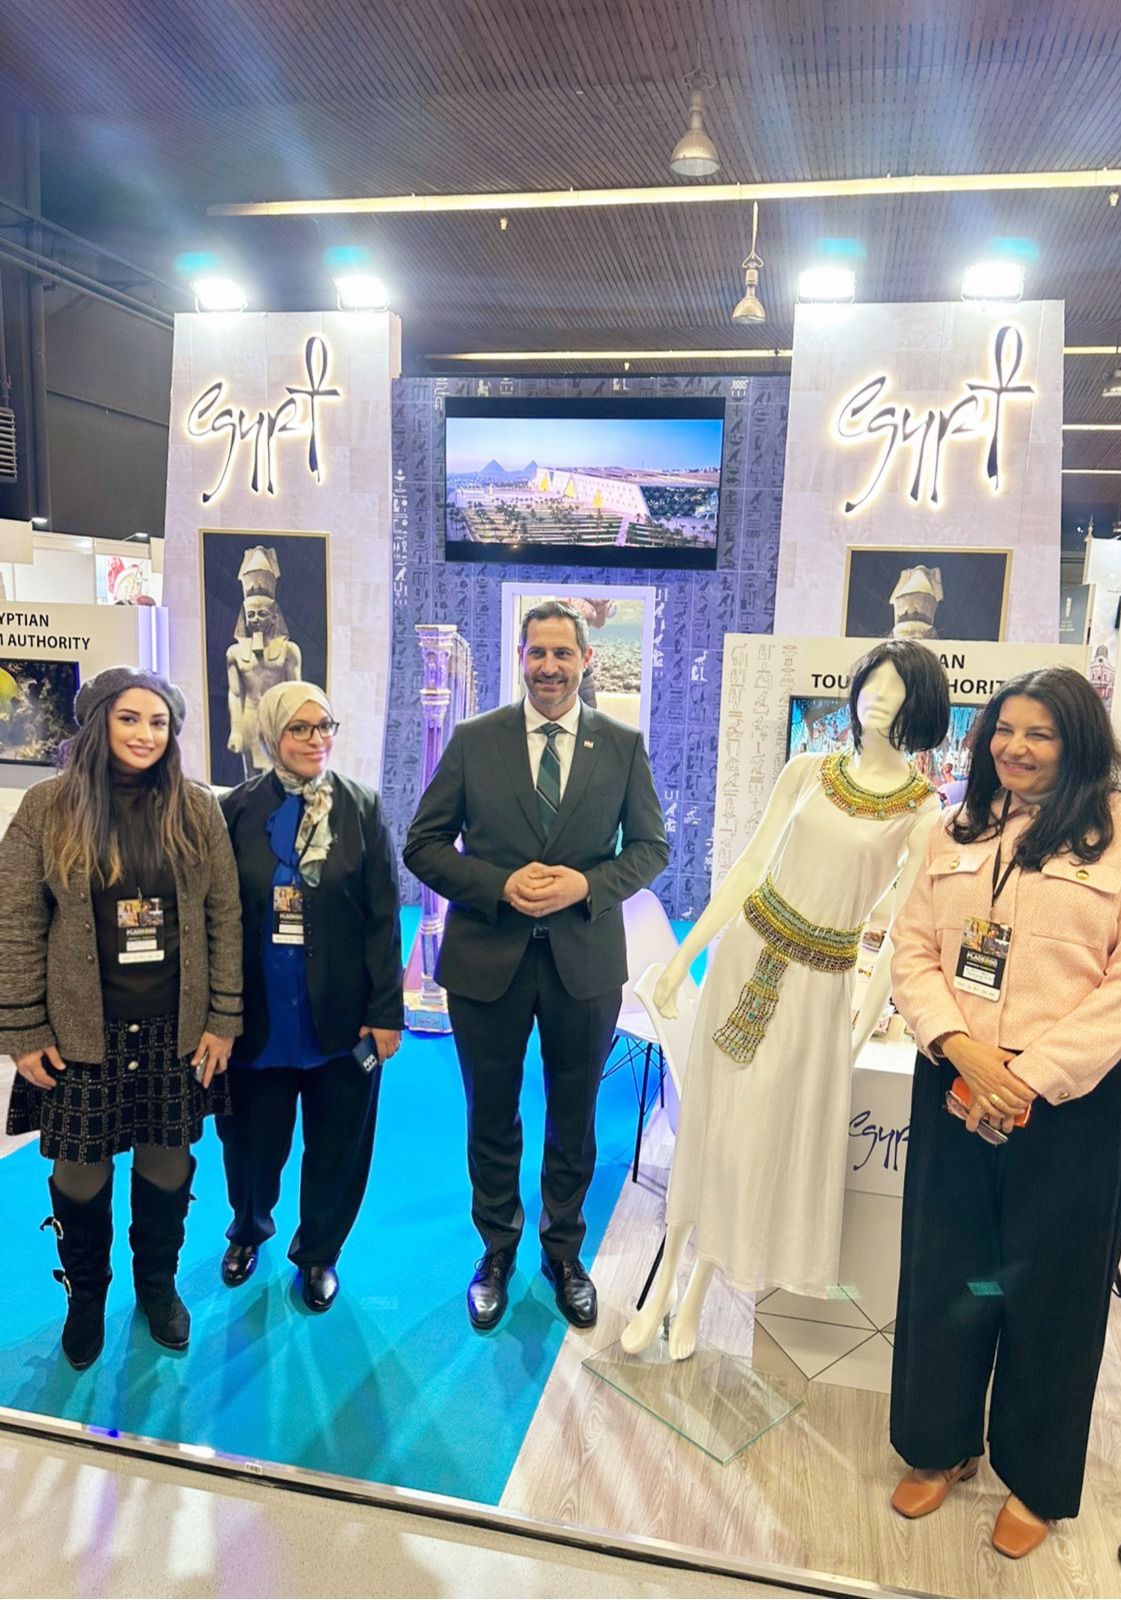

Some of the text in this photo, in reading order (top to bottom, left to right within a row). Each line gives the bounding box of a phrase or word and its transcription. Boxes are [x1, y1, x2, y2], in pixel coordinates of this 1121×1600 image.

[0, 612, 49, 627] YPTIAN
[7, 633, 90, 650] AUTHORITY
[940, 654, 965, 669] AN
[811, 674, 849, 690] TOU
